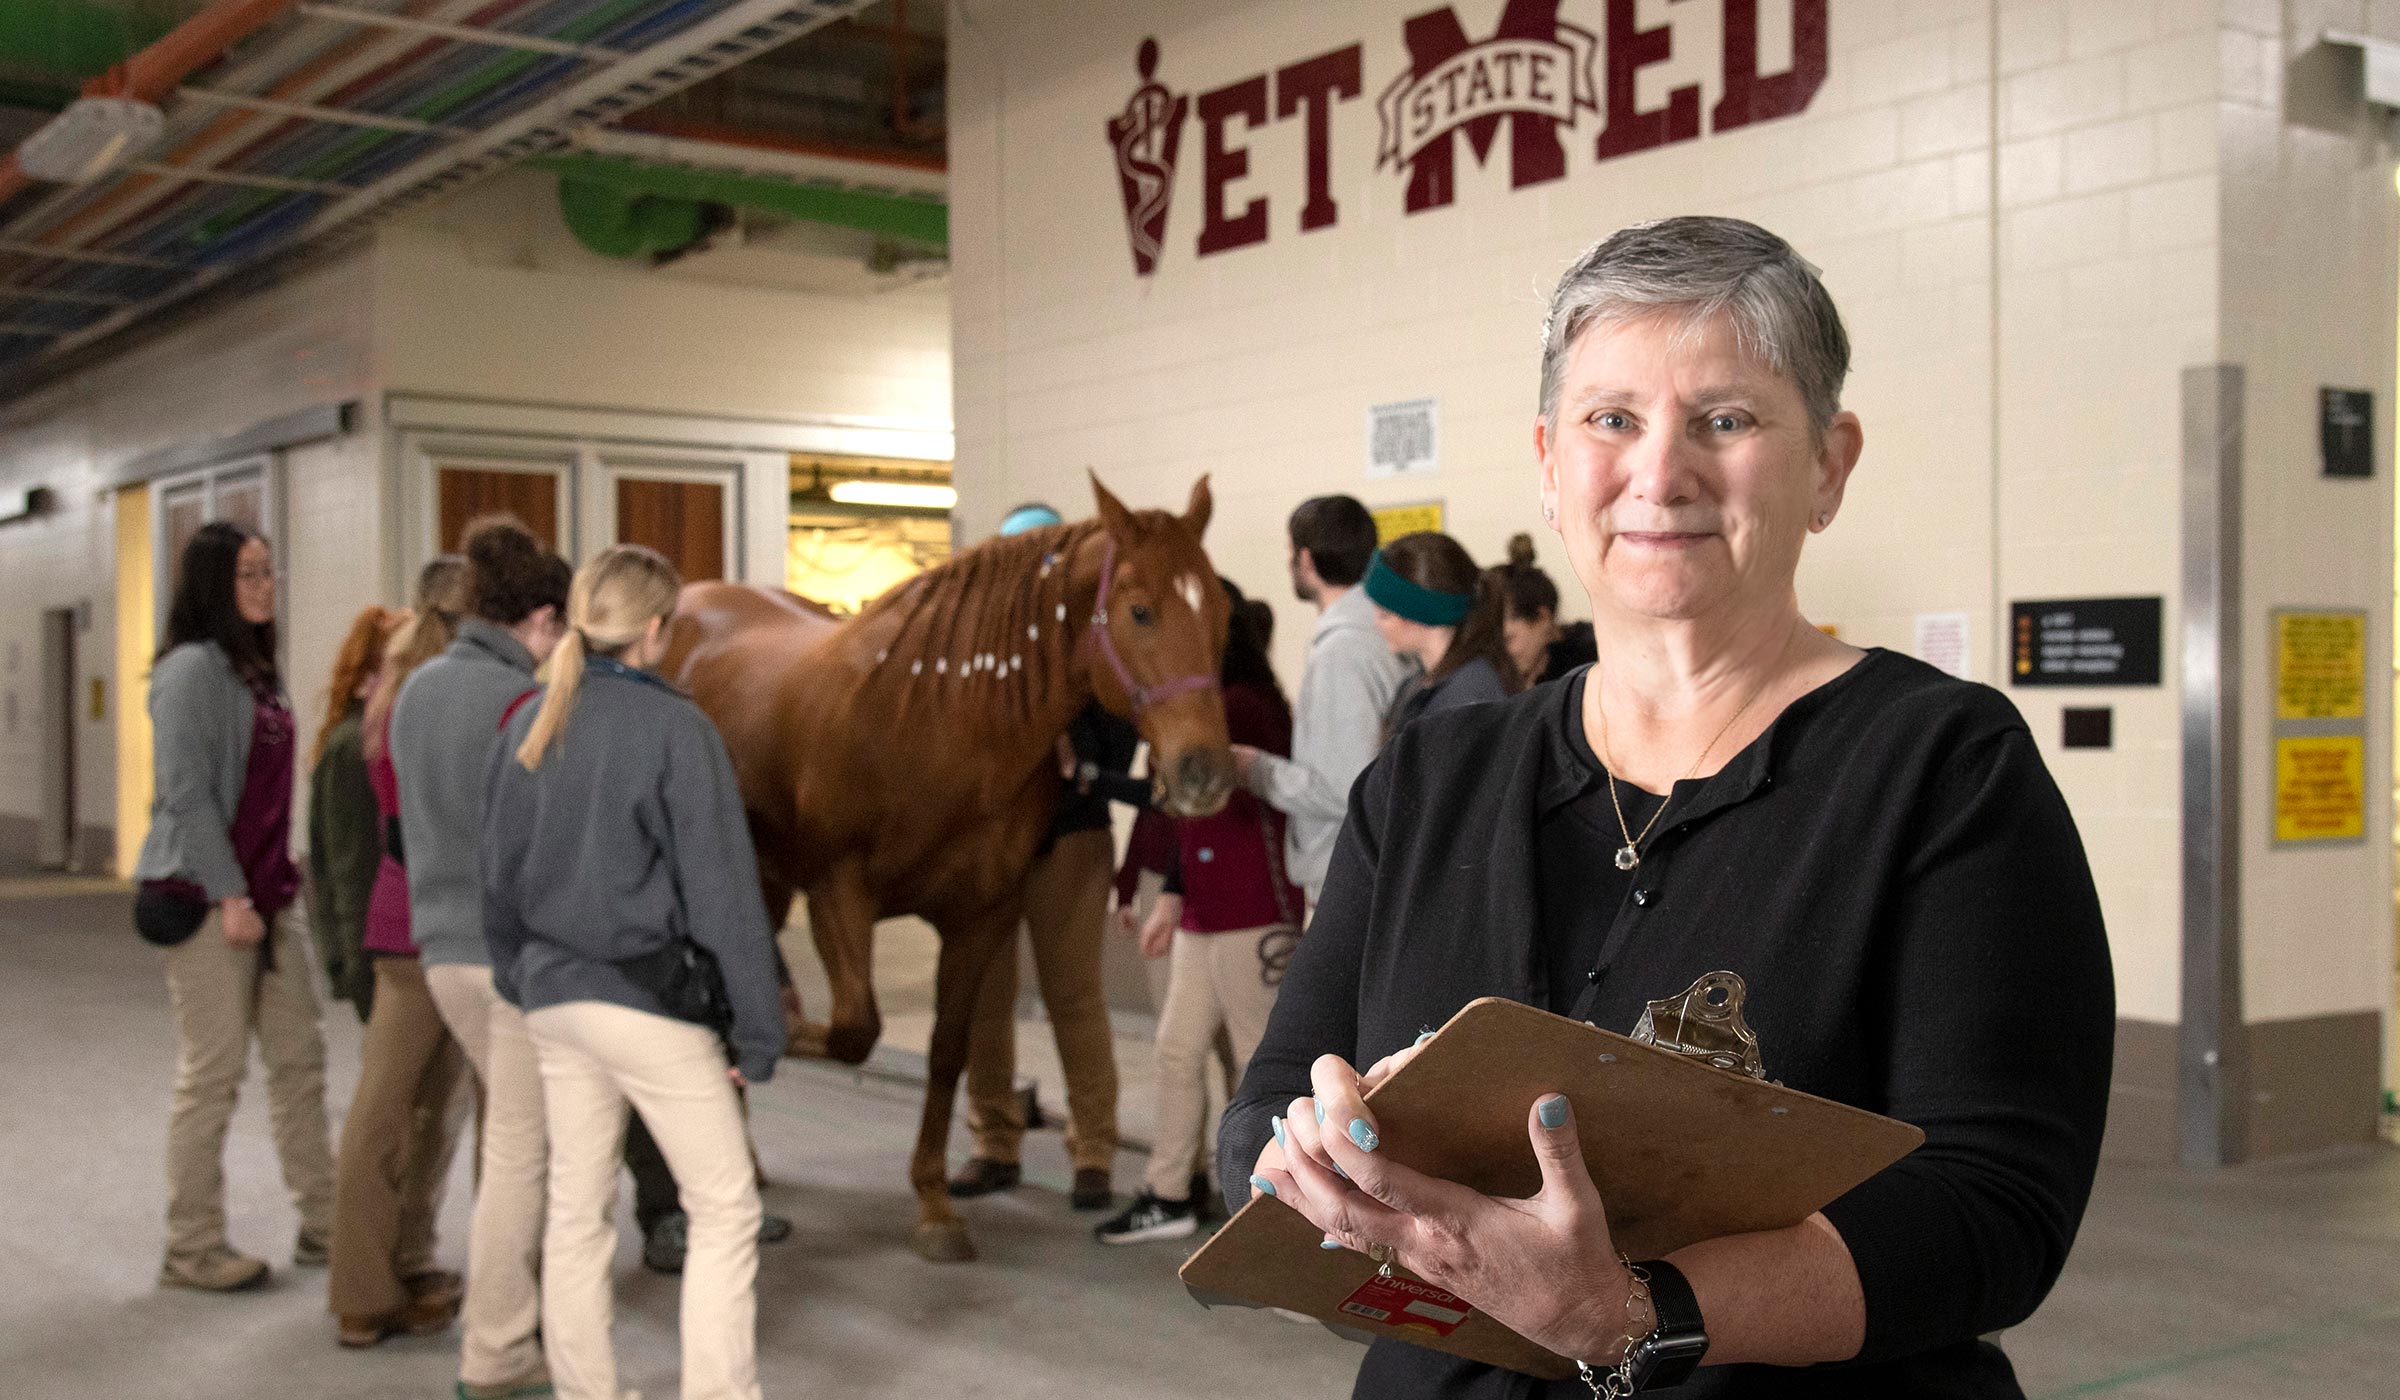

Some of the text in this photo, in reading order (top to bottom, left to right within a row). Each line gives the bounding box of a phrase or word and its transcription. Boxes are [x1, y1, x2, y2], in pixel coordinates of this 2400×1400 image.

[1107, 0, 1830, 276] VET MED
[1410, 50, 1557, 139] STATE
